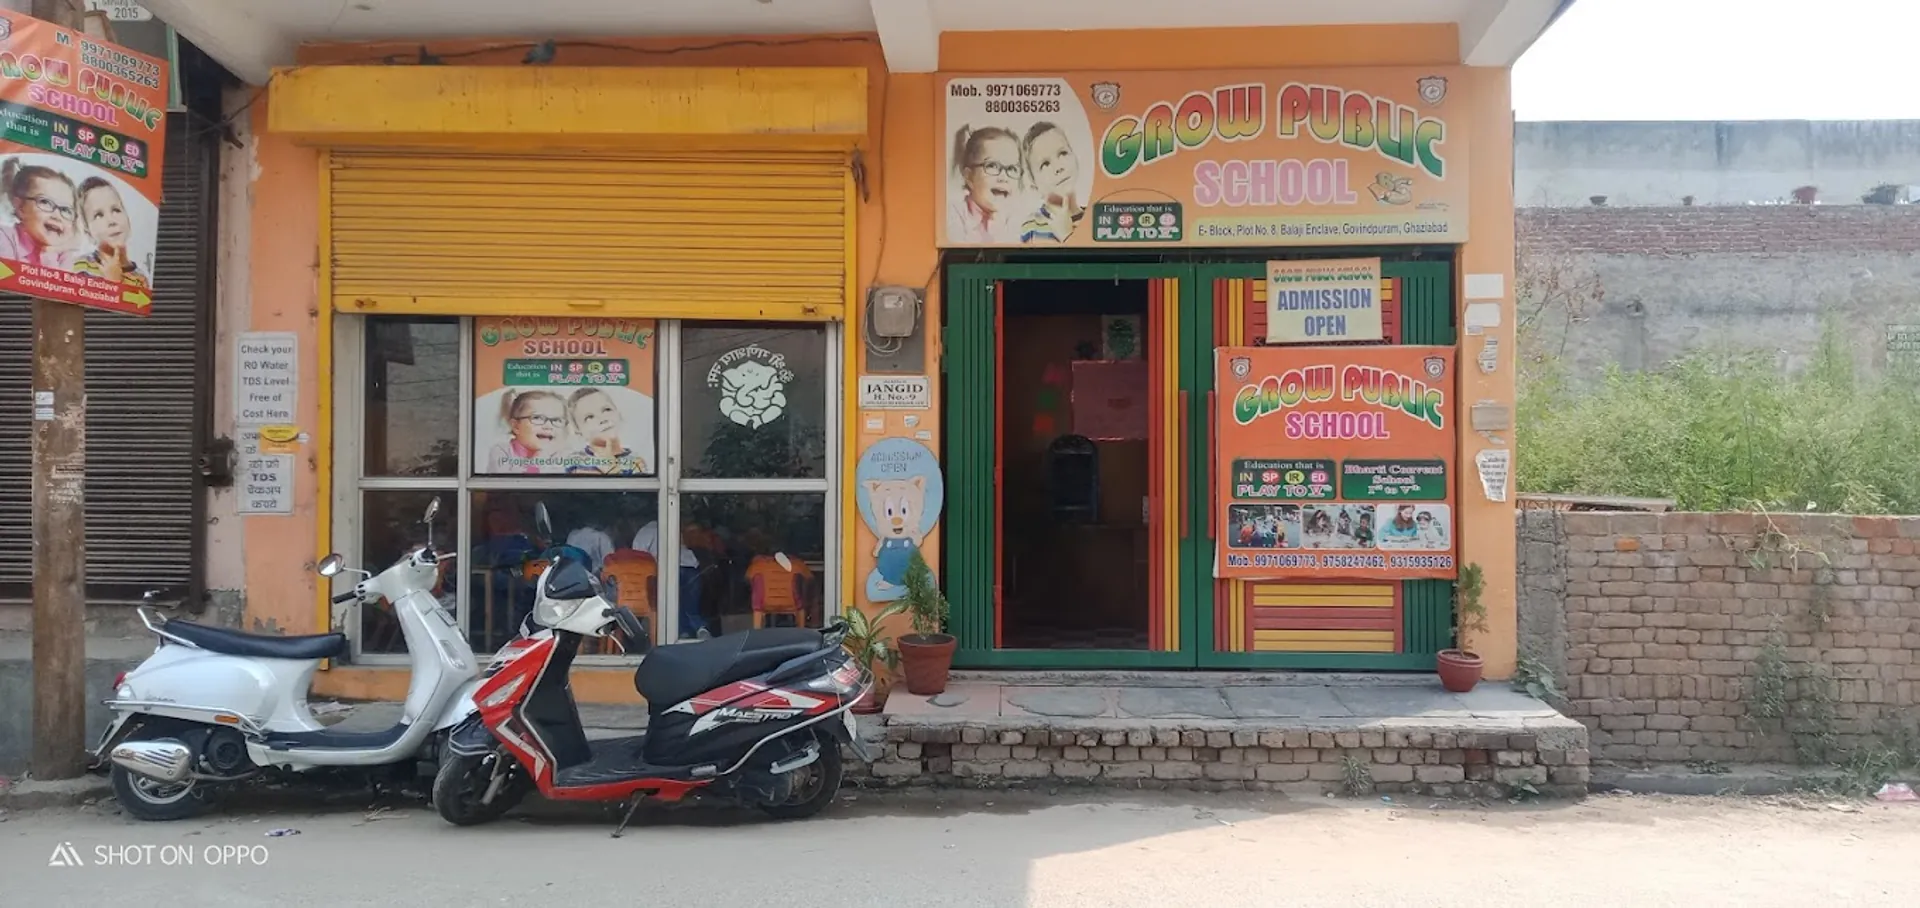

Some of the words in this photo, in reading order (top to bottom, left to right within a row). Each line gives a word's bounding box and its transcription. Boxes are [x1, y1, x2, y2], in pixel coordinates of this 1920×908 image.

[114, 7, 138, 19] 2015
[56, 31, 74, 47] M.
[80, 40, 160, 76] 9971069773
[81, 53, 160, 89] 8800365263
[0, 51, 71, 88] ROW
[78, 68, 164, 133] PUBLIC
[950, 84, 982, 97] Mob.
[985, 84, 1062, 97] 9971069773
[28, 84, 120, 127] SCHOOL
[985, 100, 1061, 113] 8800365263
[0, 107, 49, 127] ducation
[5, 120, 28, 134] that
[29, 126, 40, 137] is
[1101, 83, 1266, 179] GROW
[1277, 82, 1446, 181] PUBLIC
[53, 121, 69, 136] IN
[77, 129, 96, 142] SP
[125, 143, 141, 157] ED
[51, 135, 96, 159] PLAY
[98, 148, 121, 168] TO
[1194, 159, 1358, 207] SCHOOL
[1103, 204, 1145, 213] Education
[1146, 204, 1162, 213] that
[1098, 215, 1112, 225] IN
[1118, 215, 1134, 225] SP
[1096, 227, 1135, 239] PLAY
[1136, 227, 1158, 239] TO
[1209, 224, 1236, 237] Block,
[1236, 223, 1254, 236] Plot
[1280, 223, 1303, 237] Balaji
[1305, 222, 1341, 236] Enclave,
[1342, 222, 1402, 236] Govindpuram,
[1403, 221, 1449, 234] Ghaziabad
[21, 263, 39, 276] Plot
[87, 278, 120, 293] Enclave
[18, 276, 77, 297] Govindpuram,
[78, 287, 120, 305] Ghaziabad
[1277, 287, 1372, 311] ADMISSION
[1304, 314, 1347, 337] OPEN
[481, 316, 560, 346] GROW
[567, 316, 655, 349] PUBLIC
[241, 345, 268, 354] Check
[271, 347, 293, 356] your
[523, 338, 608, 357] SCHOOL
[260, 361, 289, 370] Water
[507, 362, 547, 370] Education
[550, 364, 562, 372] IN
[568, 363, 583, 373] SP
[608, 363, 622, 373] ED
[242, 376, 262, 386] TDS
[264, 377, 290, 386] Level
[548, 373, 584, 384] PLAY
[585, 373, 606, 384] TO
[866, 384, 924, 394] JANGID
[249, 392, 270, 402] Free
[272, 393, 282, 402] of
[1234, 364, 1335, 426] GROW
[1343, 364, 1444, 431] PUBLIC
[242, 409, 264, 418] Cost
[266, 409, 290, 418] Here
[1285, 411, 1390, 440] SCHOOL
[881, 463, 907, 473] OPEN
[1244, 460, 1293, 469] Education
[1295, 461, 1314, 469] that
[1344, 464, 1387, 474] Bharti
[1388, 464, 1443, 474] Convent
[251, 473, 277, 482] TDS
[1239, 472, 1254, 482] IN
[1262, 472, 1280, 482] SP
[1288, 472, 1302, 482] IR
[1311, 472, 1327, 482] ED
[1372, 475, 1415, 485] School
[1236, 484, 1281, 497] PLAY
[1282, 484, 1308, 497] TO
[1254, 553, 1320, 570] 9971069773,
[1390, 554, 1452, 569] 9315935126
